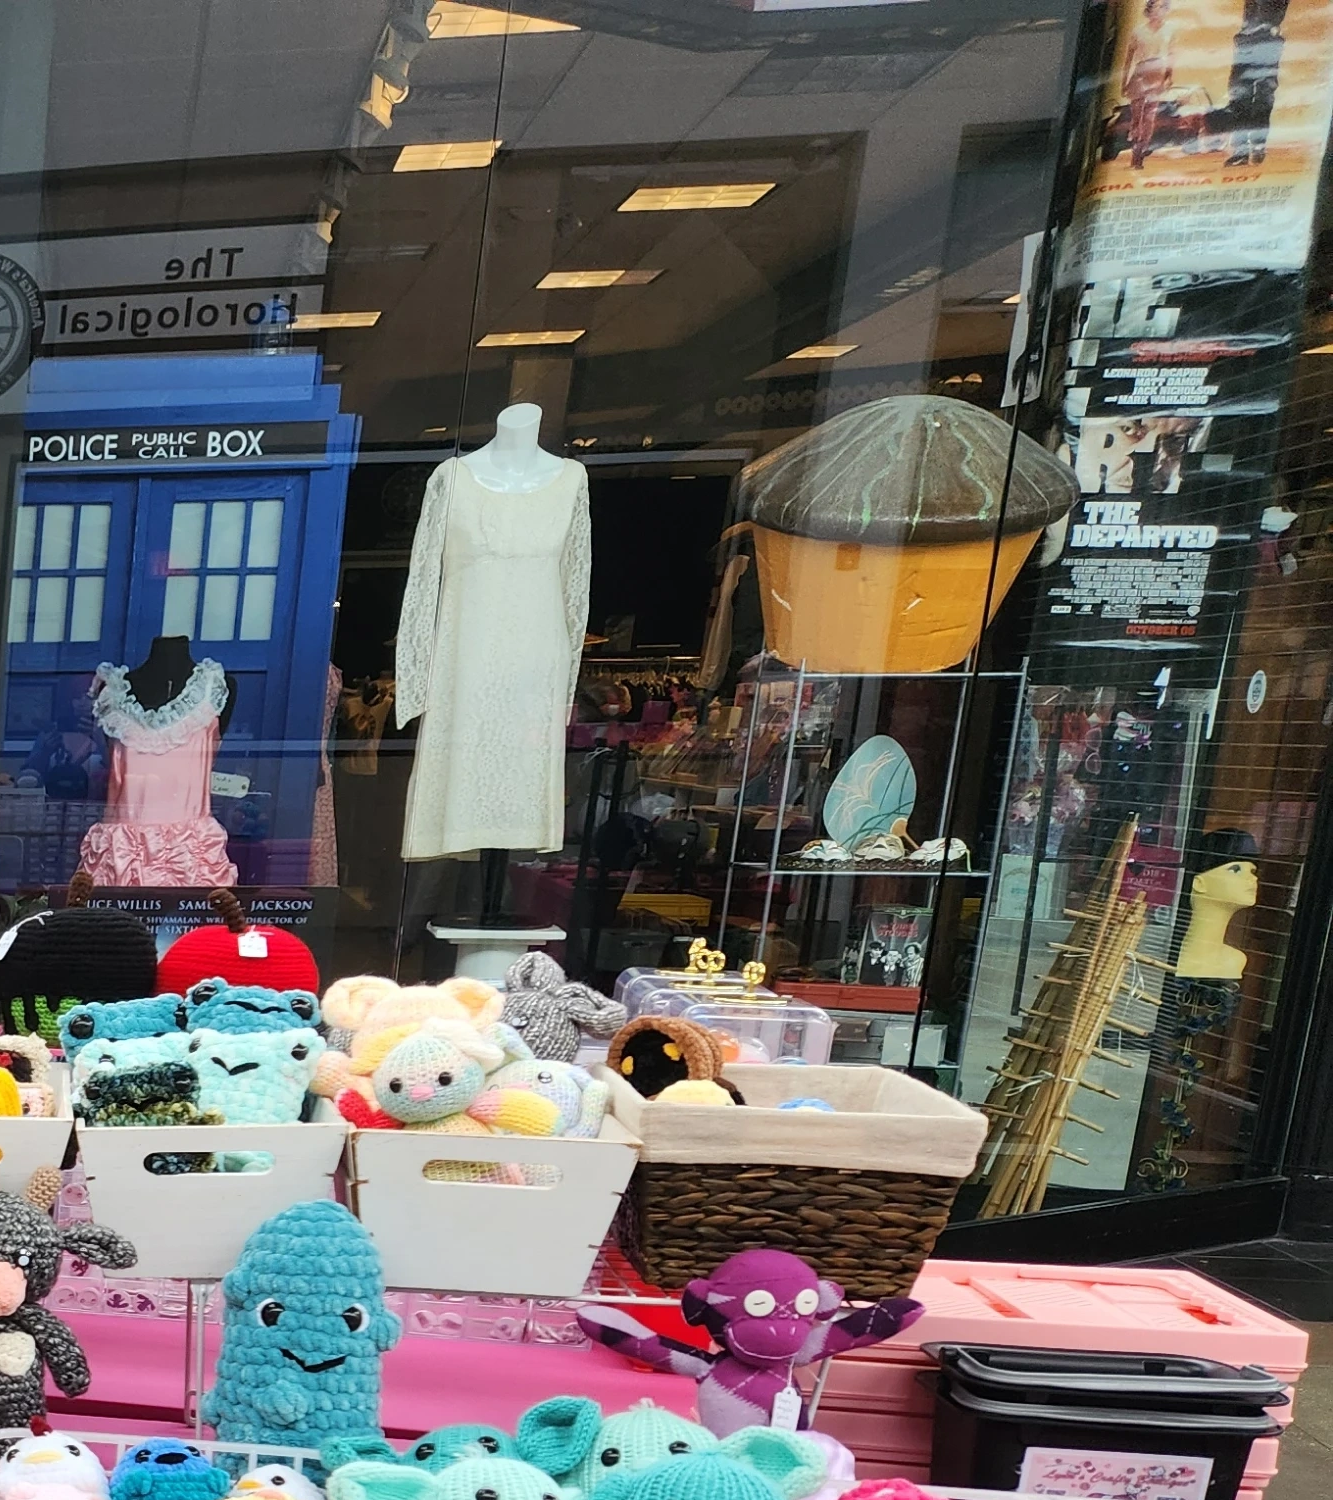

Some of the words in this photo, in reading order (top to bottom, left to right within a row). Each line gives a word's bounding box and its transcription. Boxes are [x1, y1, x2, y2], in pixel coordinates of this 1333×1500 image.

[1144, 177, 1213, 188] GONNA
[1103, 368, 1159, 378] LEONARDO
[1135, 377, 1166, 386] MATT
[1166, 377, 1205, 386] DAMON
[1133, 386, 1158, 395] JACK
[1159, 385, 1219, 395] NICHOLSON
[1117, 395, 1150, 405] MARK
[1150, 395, 1209, 405] WAHLBERG
[28, 433, 119, 462] POLICE
[132, 431, 198, 447] PUBLIC
[206, 430, 265, 458] BOX
[138, 446, 188, 459] CALL
[1084, 501, 1142, 525] THE
[1070, 525, 1218, 548] DEPARTED
[1126, 625, 1178, 635] OCTOBER
[117, 899, 162, 910] WILLIS
[178, 899, 216, 911] SAMU
[251, 899, 314, 911] JACKSON
[295, 916, 307, 924] OF
[1090, 1471, 1132, 1486] Crafty
